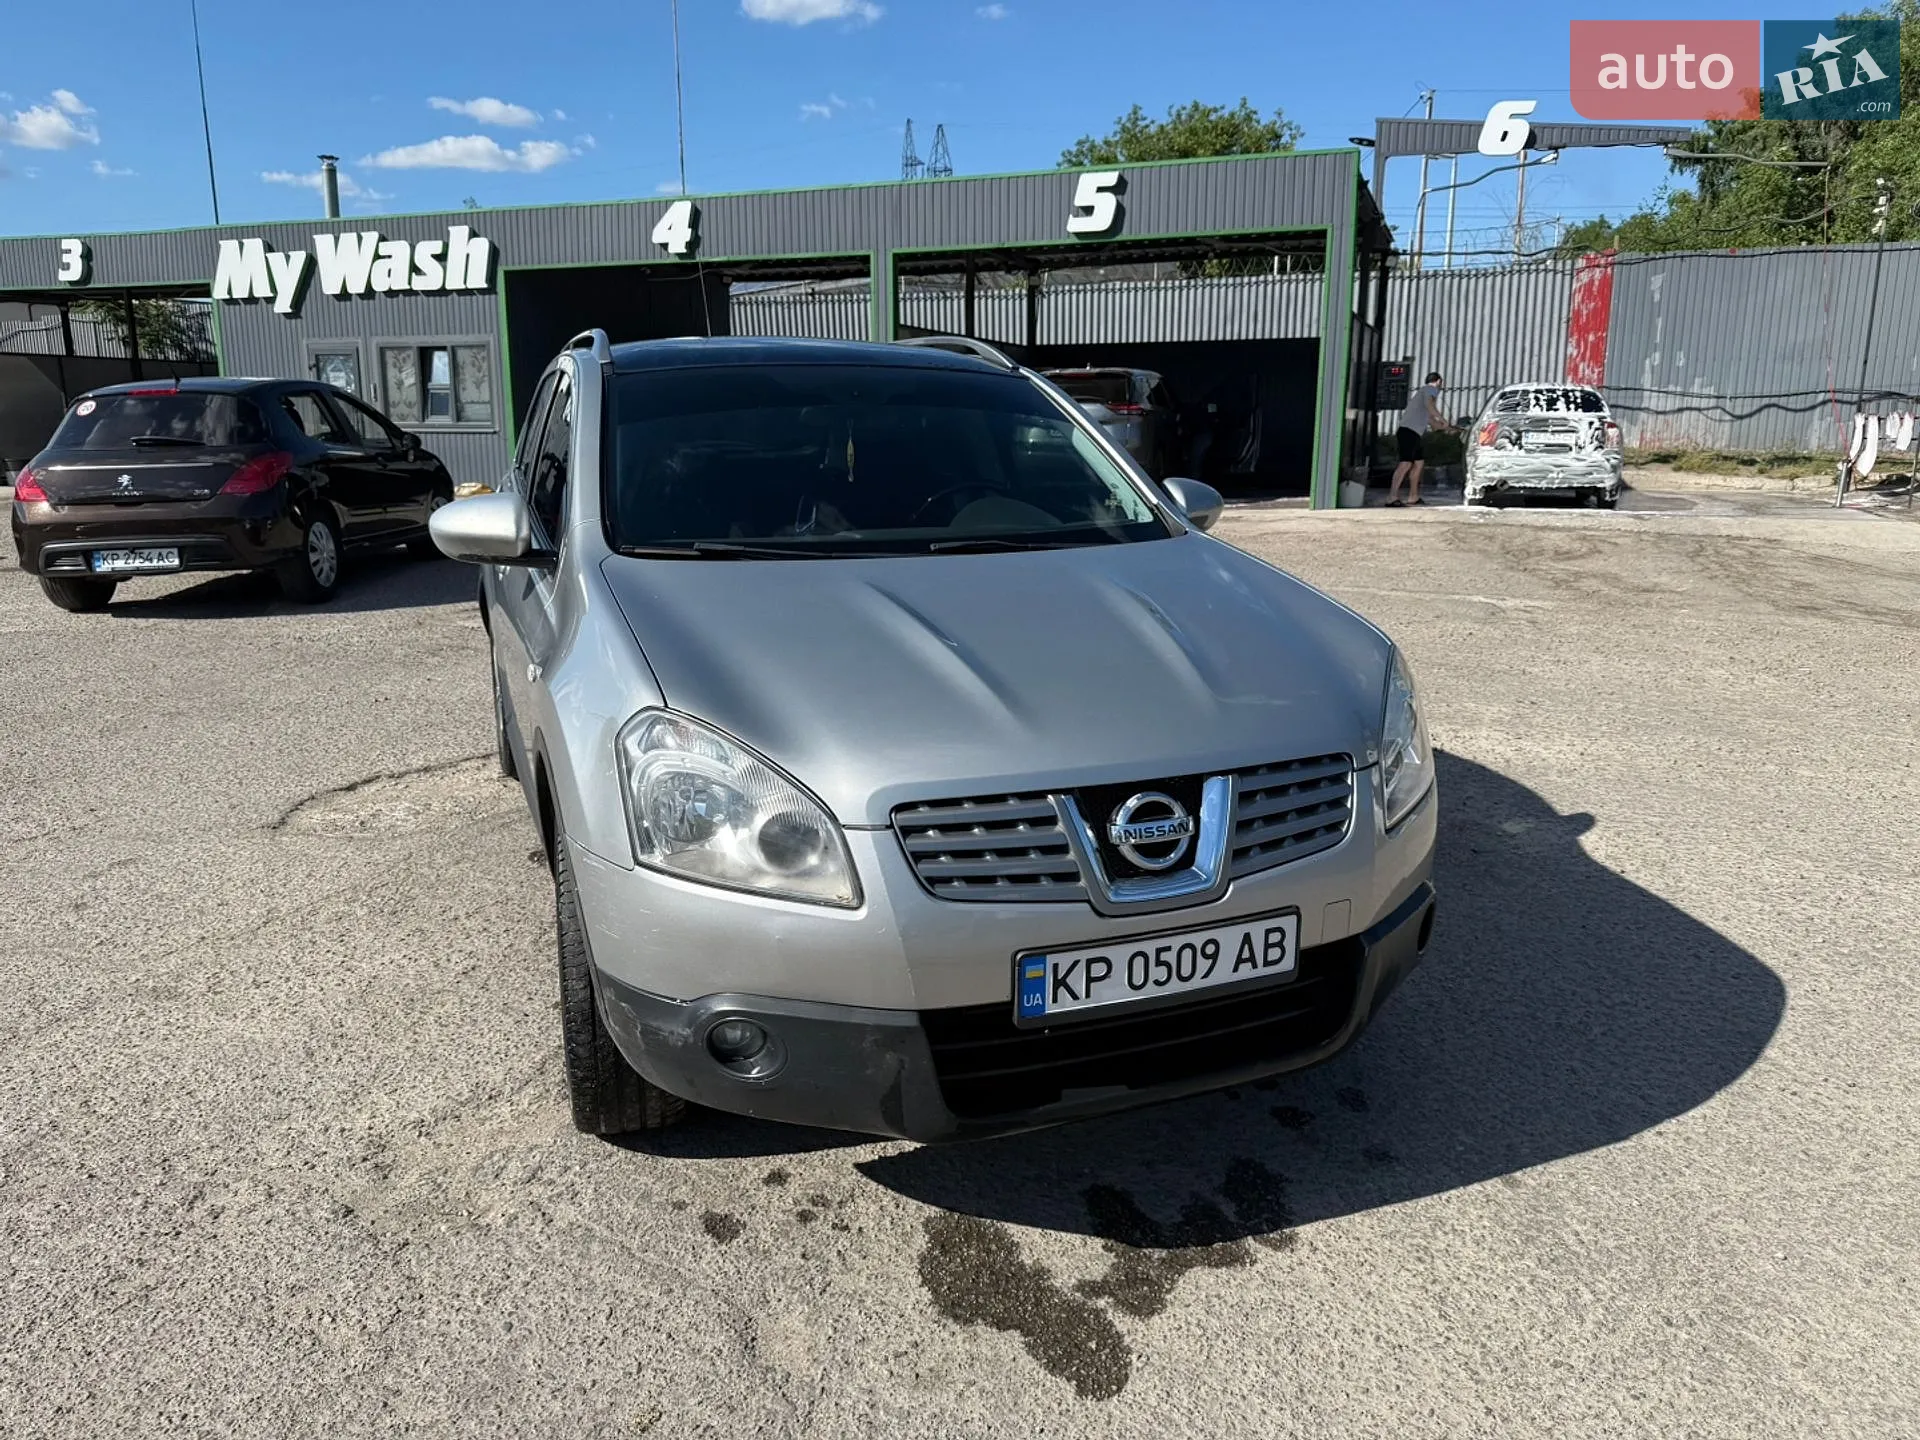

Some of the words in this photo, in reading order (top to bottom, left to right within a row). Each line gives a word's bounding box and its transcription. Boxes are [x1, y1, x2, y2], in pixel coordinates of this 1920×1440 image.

[1477, 100, 1538, 156] 6
[651, 199, 695, 255] 4
[1067, 170, 1120, 234] 5
[58, 238, 83, 281] 3
[212, 237, 307, 313] My
[312, 225, 490, 295] Wash
[101, 553, 120, 566] KP
[157, 550, 175, 564] AC
[1122, 821, 1189, 842] NISSAN
[1050, 956, 1113, 1004] KP
[1126, 938, 1221, 991] 0509
[1232, 926, 1287, 973] AB
[1023, 992, 1043, 1007] UA
